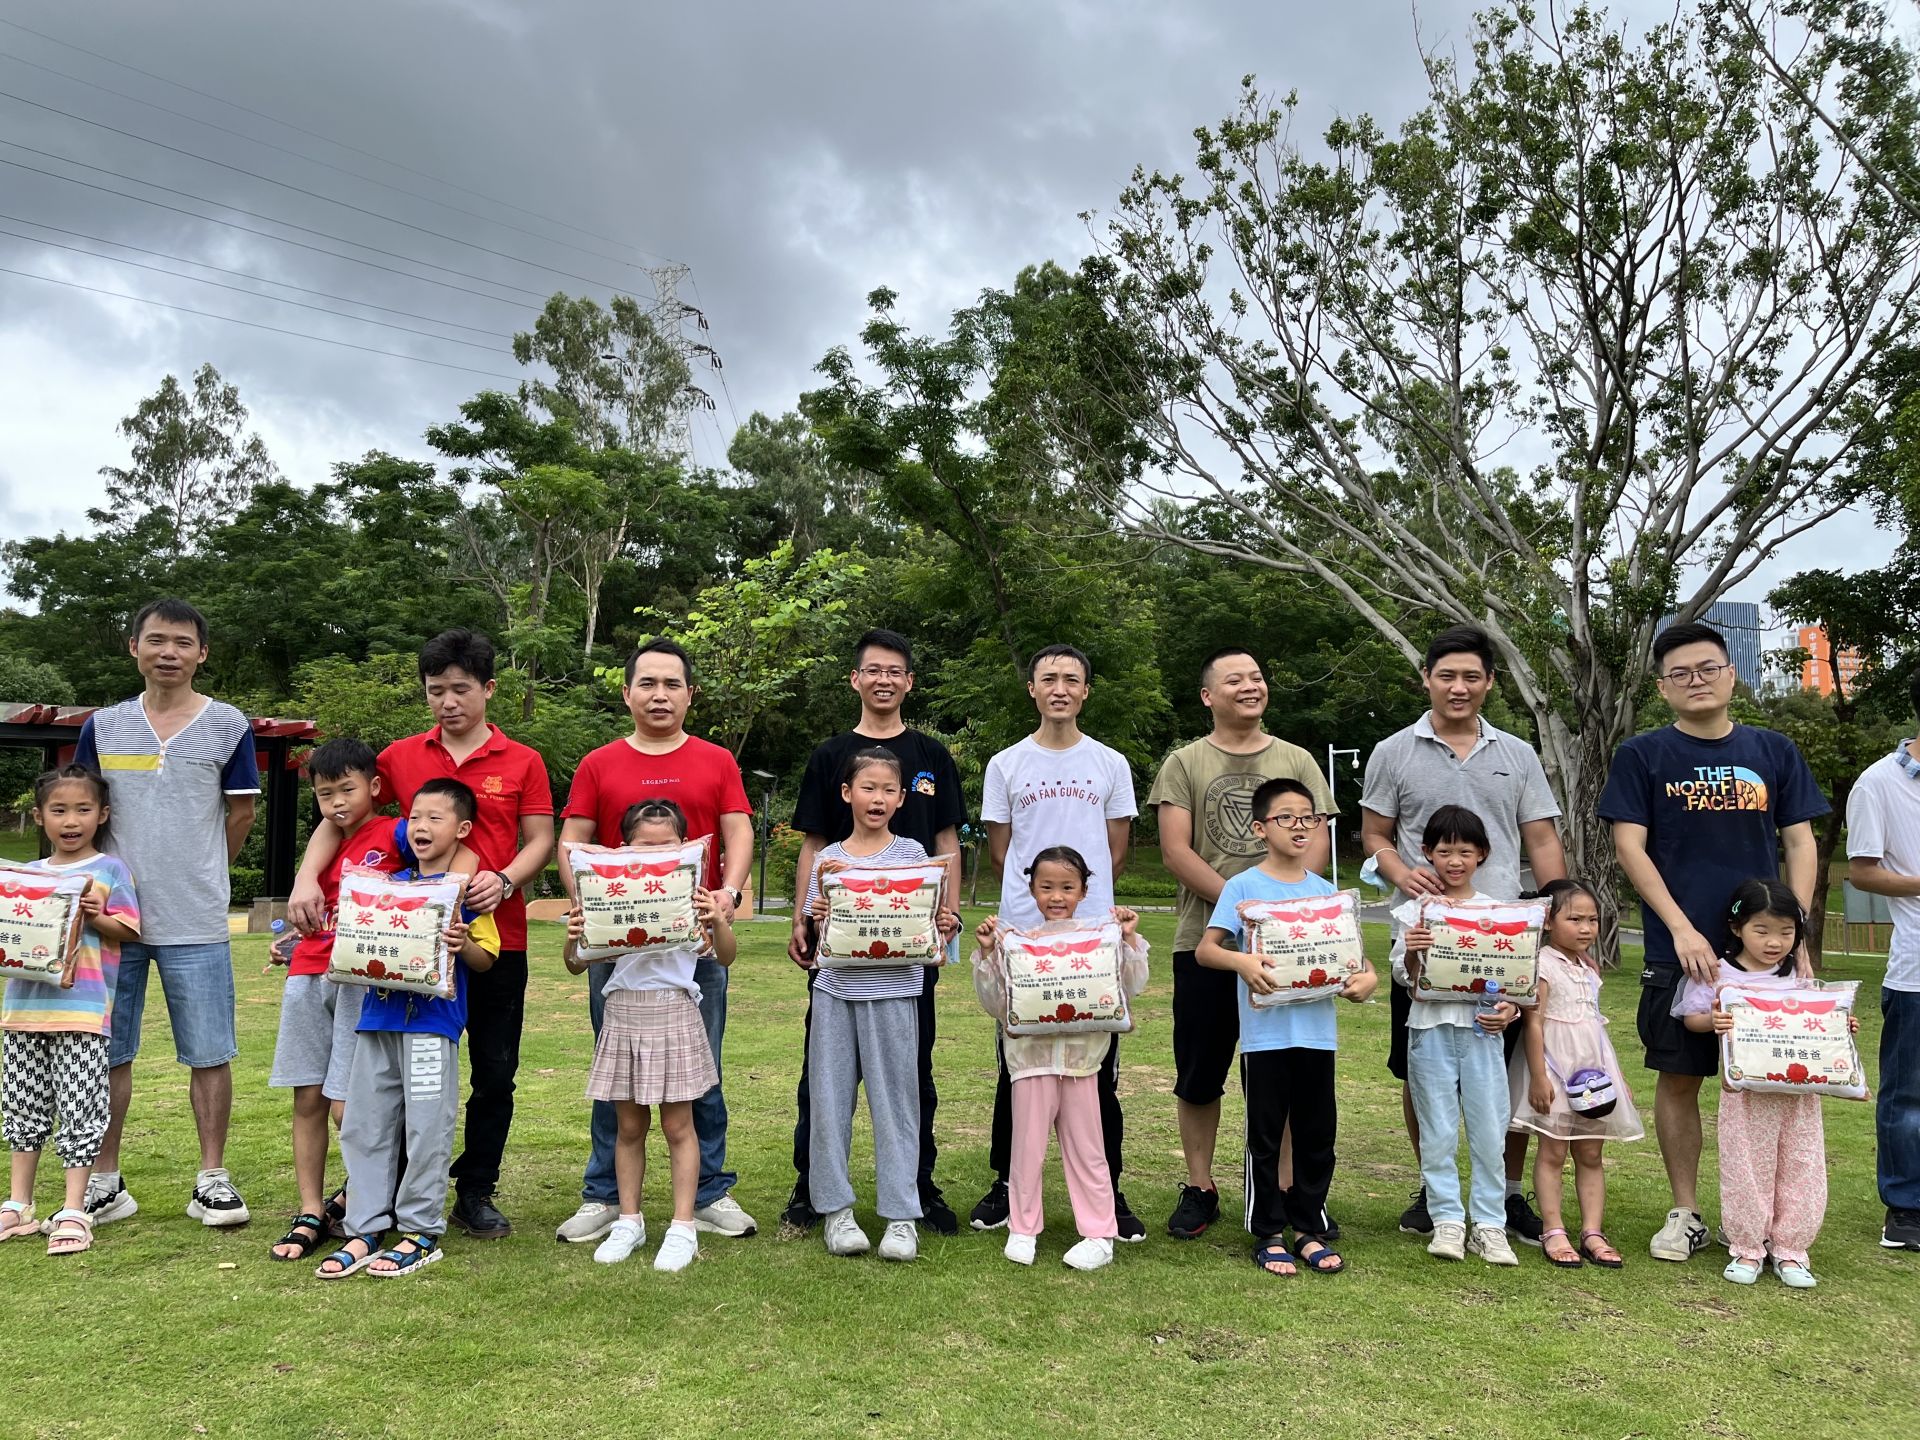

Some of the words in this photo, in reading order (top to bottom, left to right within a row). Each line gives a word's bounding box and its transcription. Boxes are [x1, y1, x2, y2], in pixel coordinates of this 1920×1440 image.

[1694, 765, 1733, 780] THE
[1665, 780, 1735, 797] NORTH
[1019, 792, 1037, 809] JUN
[1039, 788, 1057, 800] FAN
[1060, 787, 1086, 799] GUNG
[1086, 792, 1100, 806] FU
[1687, 795, 1737, 811] FACE
[604, 879, 667, 898] 奖状
[12, 902, 34, 918] 状
[853, 896, 910, 911] 奖状
[355, 910, 410, 930] 奖状
[612, 912, 660, 925] 最棒爸爸
[858, 926, 903, 938] 最棒爸爸
[1287, 922, 1341, 940] 奖状
[356, 943, 400, 958] 最棒爸爸
[1456, 935, 1515, 952] 奖状
[1034, 956, 1093, 974] 奖状
[1296, 952, 1338, 966] 最棒爸爸
[1460, 964, 1506, 977] 最棒爸爸
[1042, 988, 1088, 1001] 最棒爸爸
[1763, 1015, 1827, 1032] 奖状
[1772, 1047, 1822, 1061] 最棒爸爸
